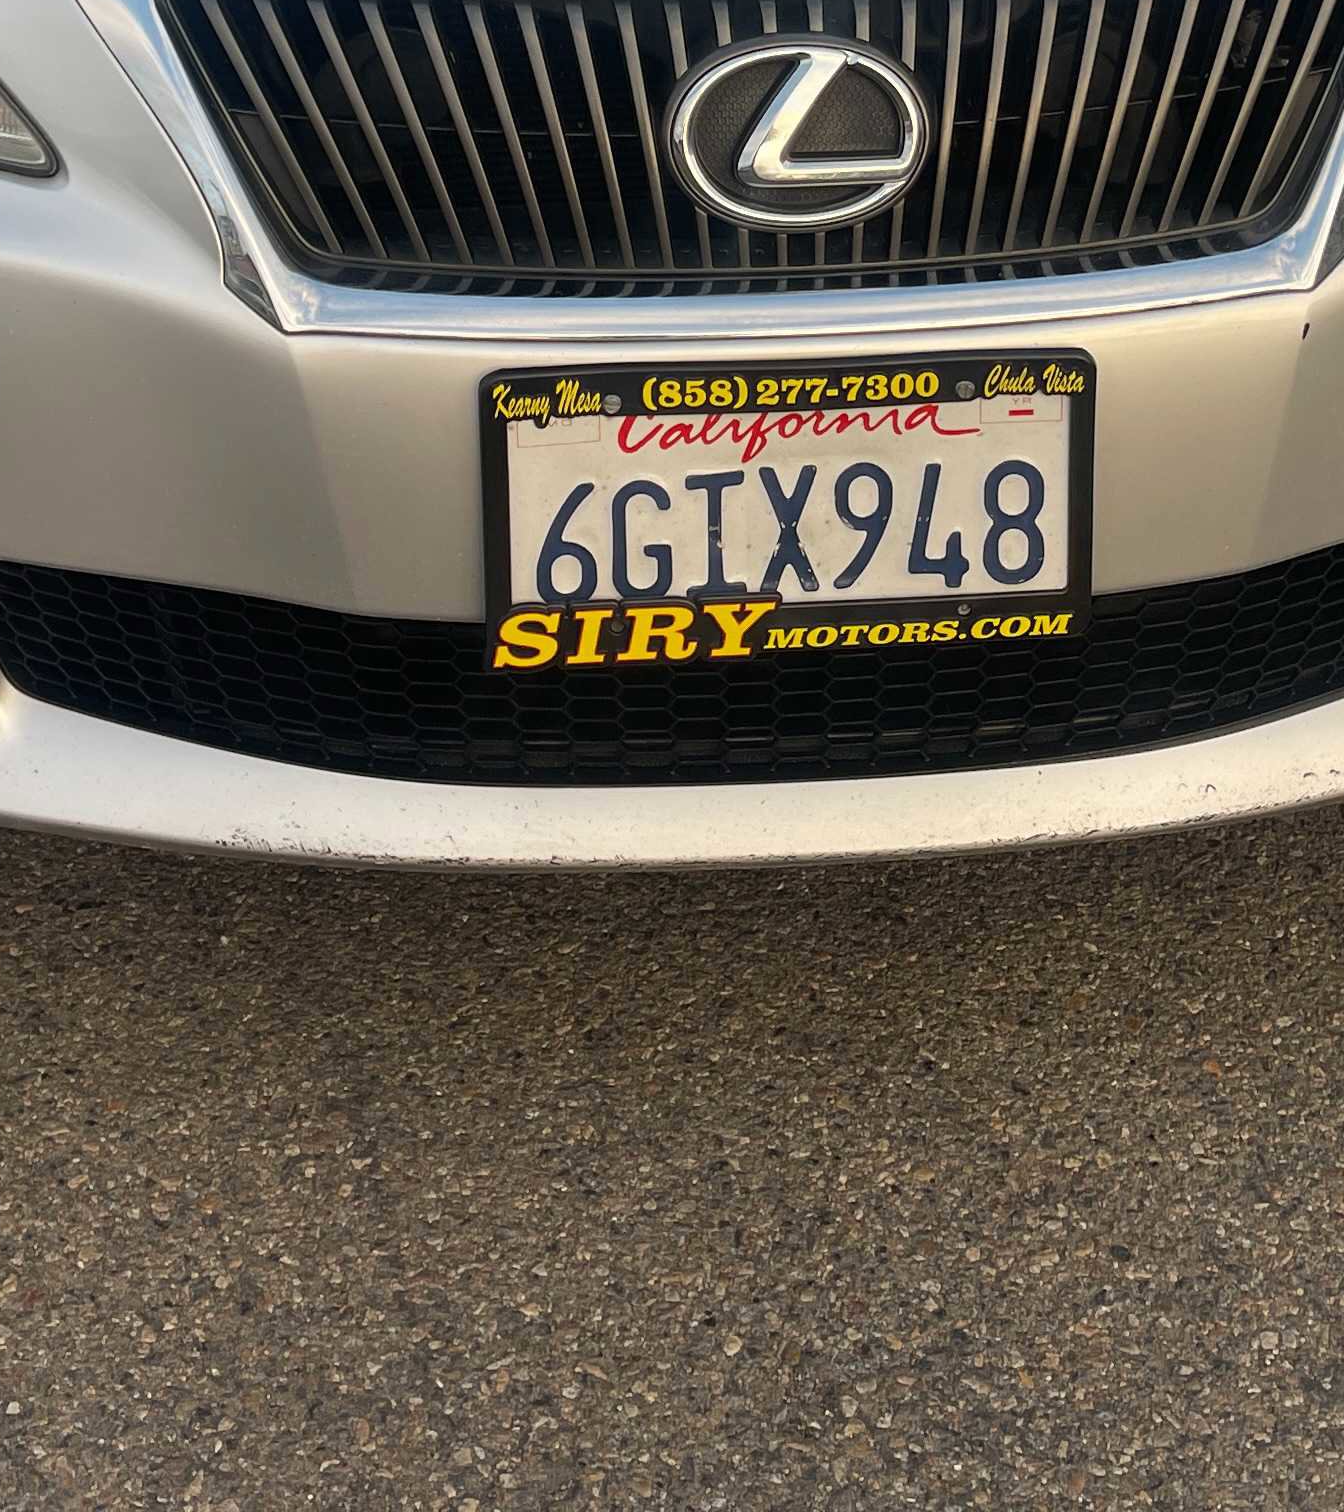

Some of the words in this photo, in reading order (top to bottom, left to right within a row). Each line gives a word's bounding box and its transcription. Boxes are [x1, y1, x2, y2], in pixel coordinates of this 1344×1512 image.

[492, 384, 550, 424] Kearny
[556, 379, 602, 415] Mesa
[642, 375, 748, 411] (858)
[757, 371, 940, 406] 277-7300
[984, 364, 1036, 398] Chula
[1042, 363, 1086, 394] Vista
[617, 402, 981, 463] California
[536, 459, 1046, 600] 6GIX948
[492, 600, 777, 669] SIRY
[762, 613, 1073, 651] MOTORS.COM
